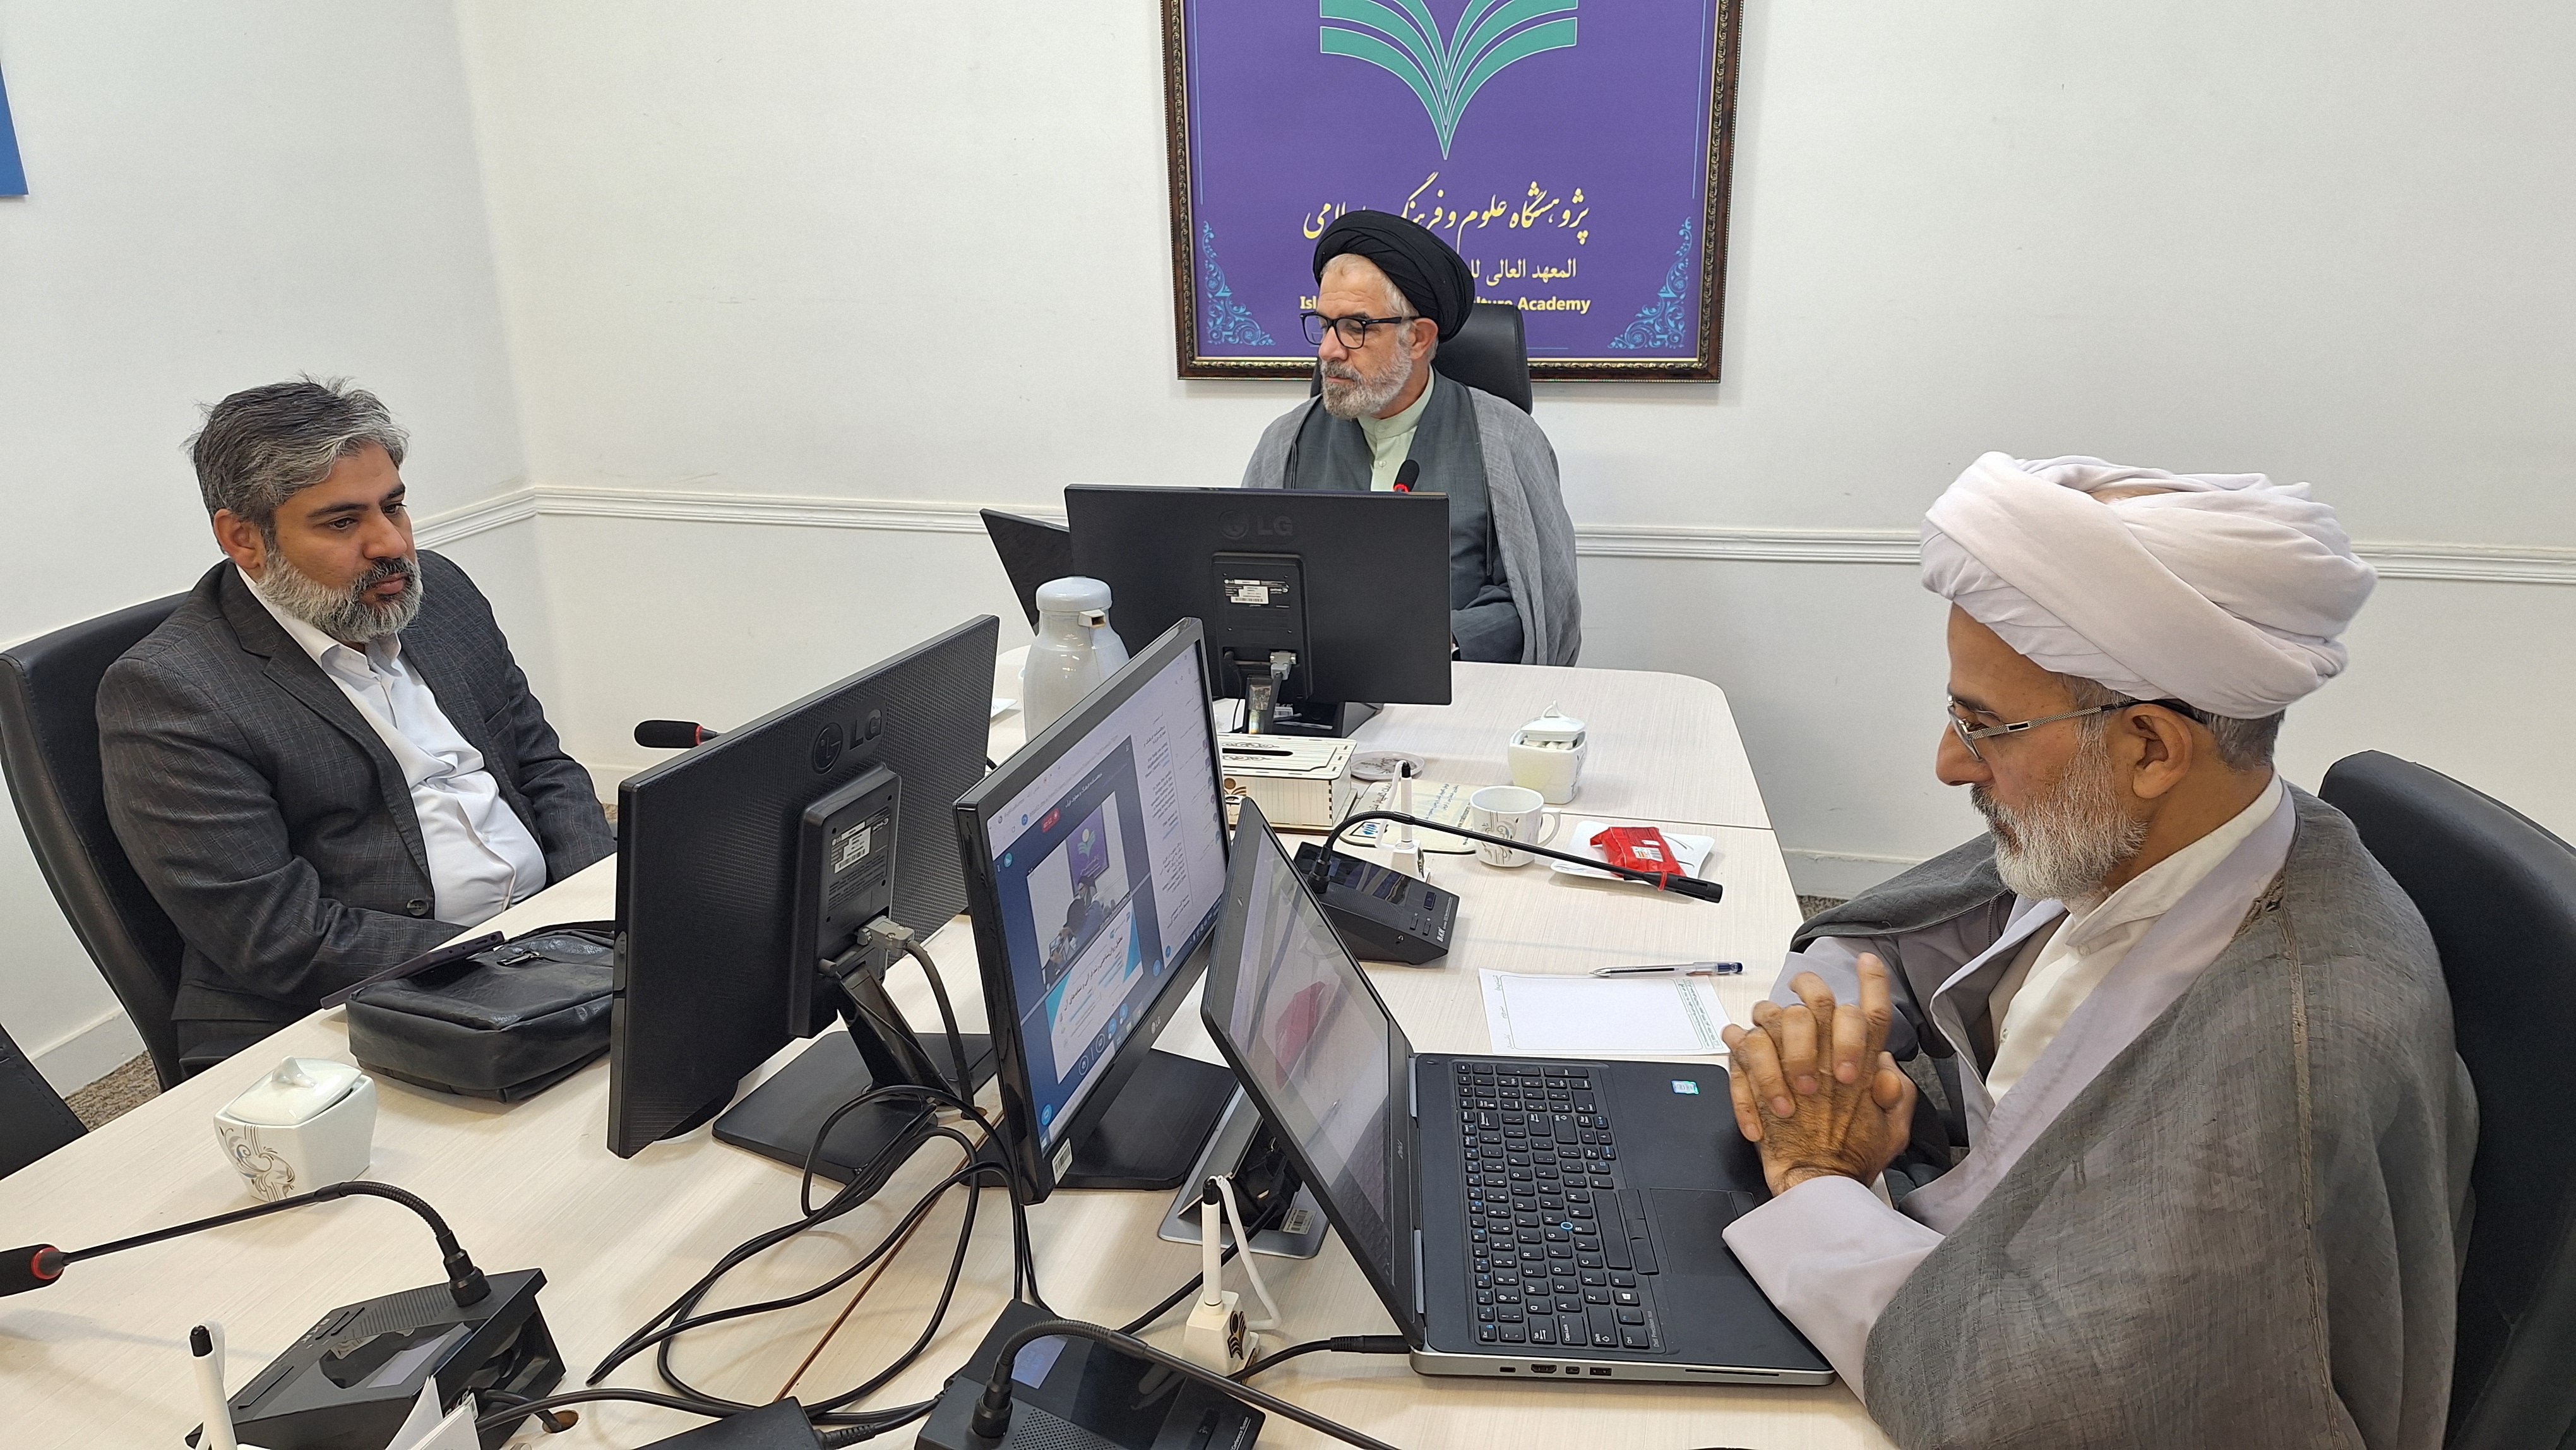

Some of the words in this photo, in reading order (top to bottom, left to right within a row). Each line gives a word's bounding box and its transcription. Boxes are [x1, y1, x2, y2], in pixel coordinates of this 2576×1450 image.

[1532, 258, 1577, 284] المعهد
[1518, 297, 1591, 315] Academy
[1257, 515, 1292, 537] LG
[849, 709, 883, 752] LG
[1155, 1016, 1161, 1028] LG
